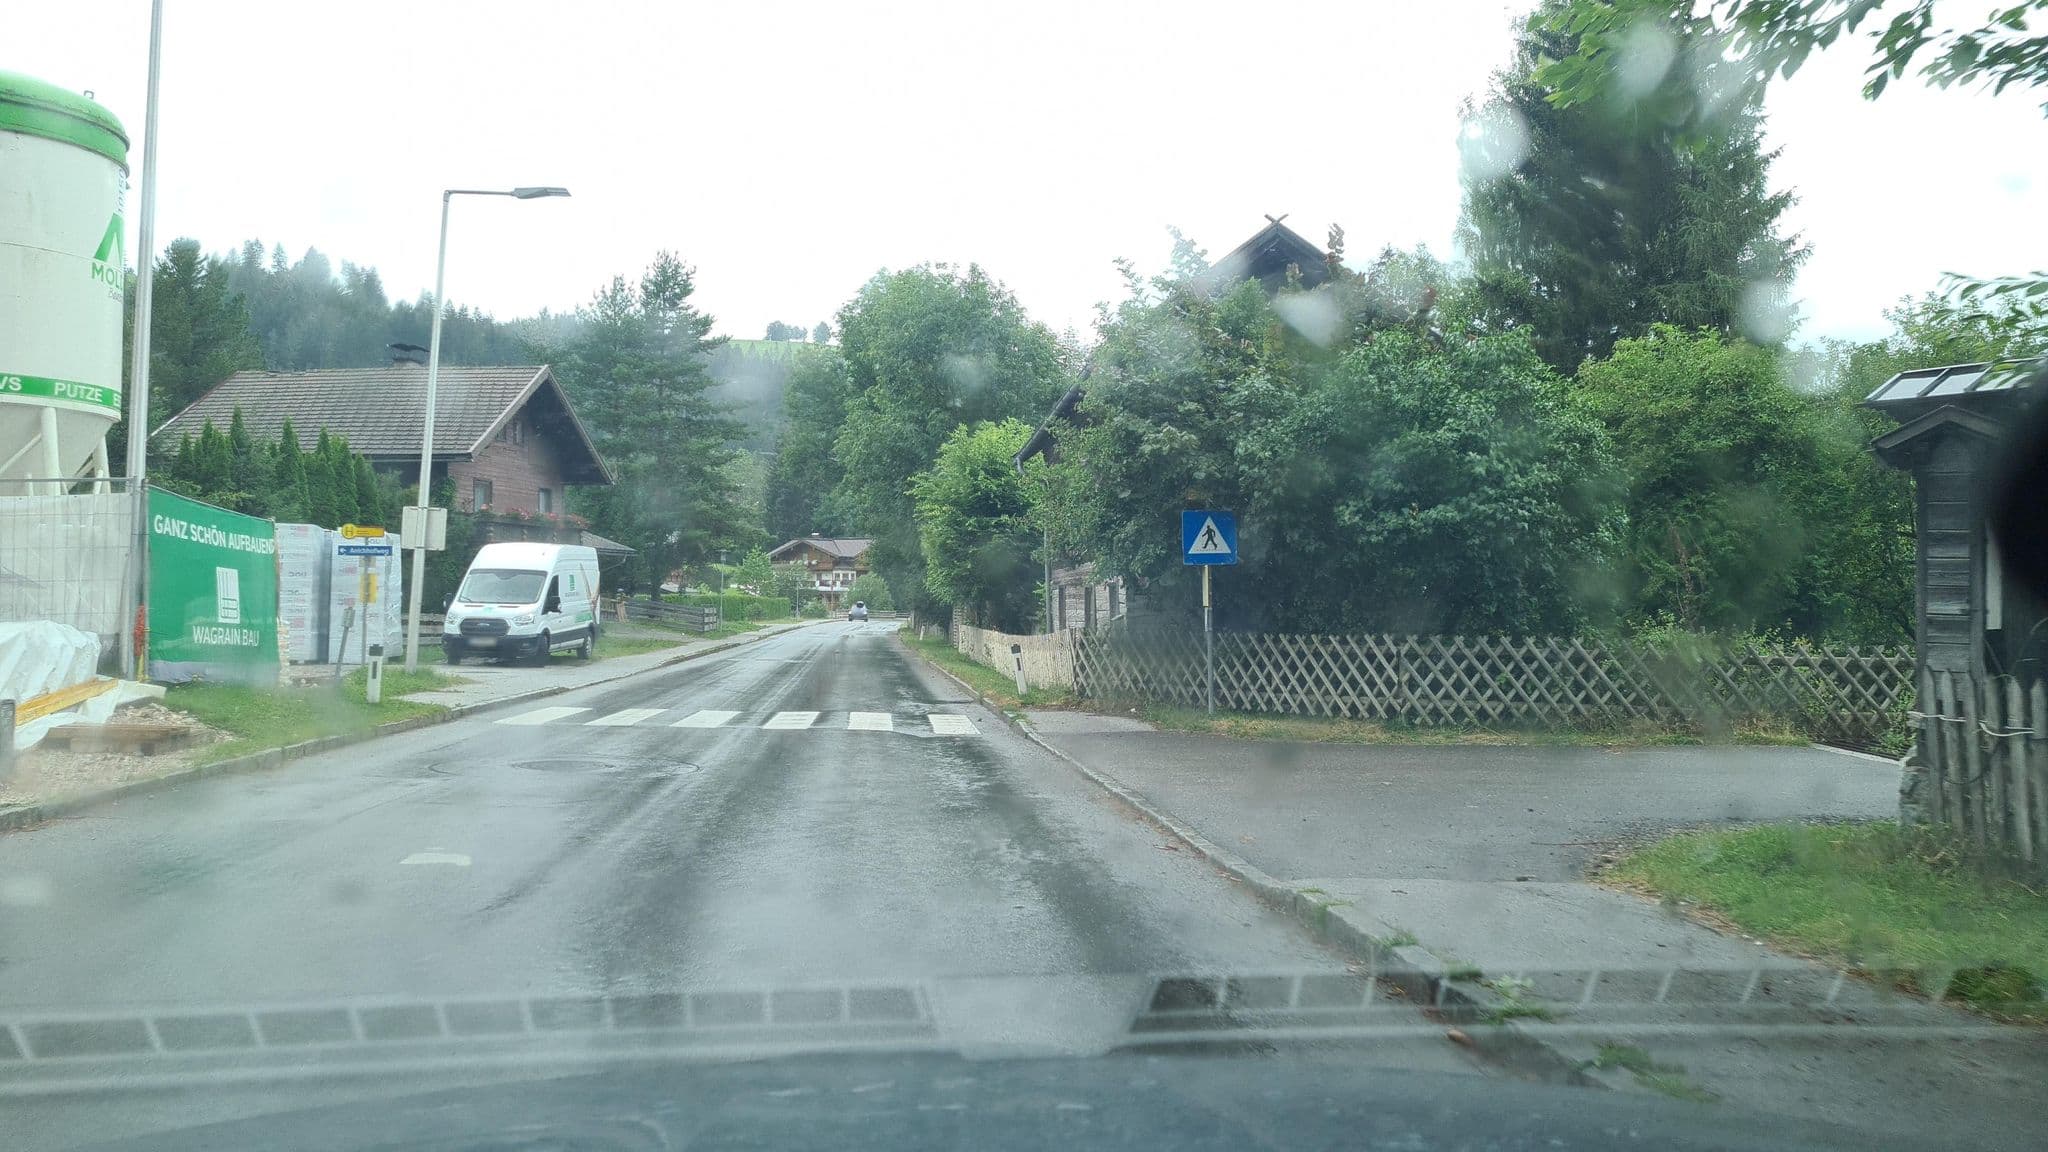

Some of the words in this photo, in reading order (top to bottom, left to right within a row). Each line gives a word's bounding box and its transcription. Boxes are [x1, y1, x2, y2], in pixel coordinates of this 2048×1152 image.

[54, 382, 103, 402] PUTZE
[154, 514, 189, 540] GANZ
[190, 523, 227, 547] SCHÖN
[192, 625, 241, 646] WAGRAIN
[242, 629, 260, 647] BAU
